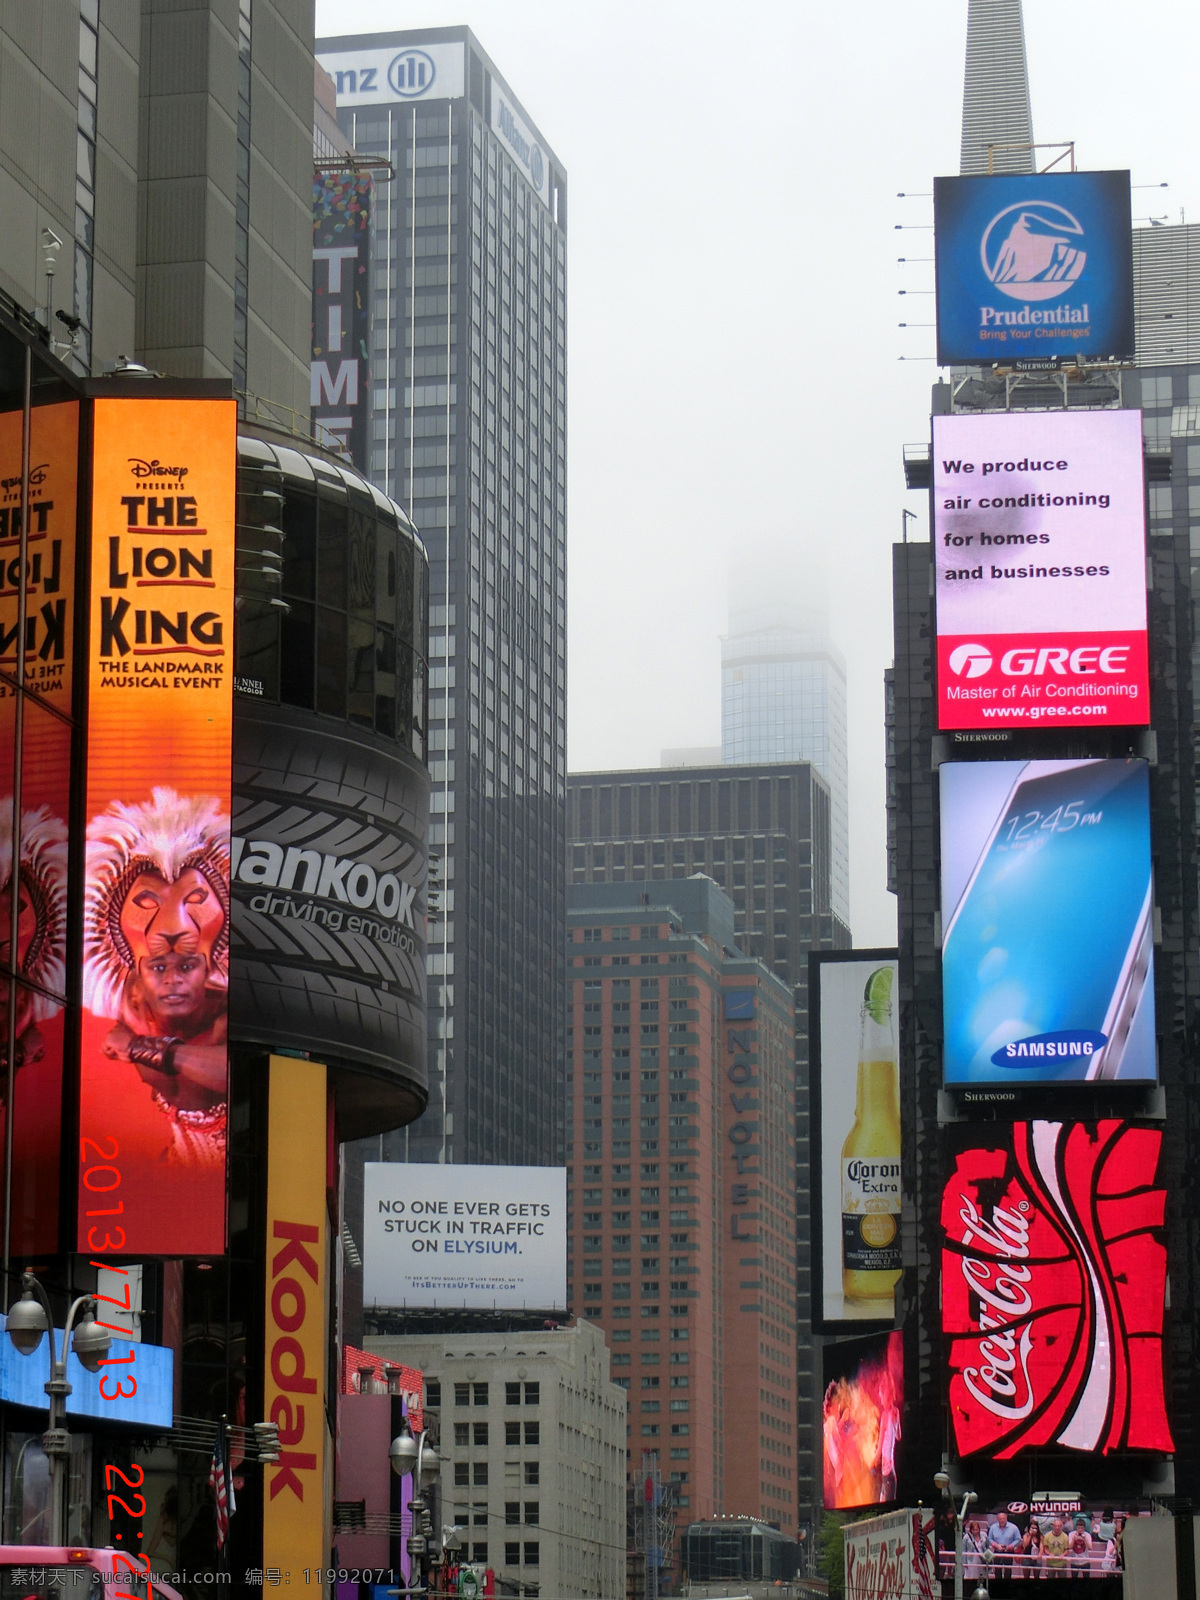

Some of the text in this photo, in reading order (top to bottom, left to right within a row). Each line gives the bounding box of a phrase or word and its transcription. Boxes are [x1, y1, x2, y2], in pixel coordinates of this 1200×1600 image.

[980, 304, 1089, 326] Prudential
[980, 327, 1089, 341] Bring Your Challenges
[943, 458, 1068, 476] We produce
[943, 492, 1110, 510] air conditioning
[121, 496, 198, 526] THE
[944, 531, 1050, 547] for homes
[108, 536, 213, 589] LION
[945, 564, 1110, 580] and businesses
[100, 596, 223, 657] KING
[99, 661, 223, 674] THE LANDMARK
[1000, 646, 1130, 676] GREE
[100, 677, 222, 688] MUSICAL EVENT
[947, 682, 1138, 700] Master of Air Conditioning
[982, 704, 1107, 719] www.gree.com
[954, 732, 1008, 742] SHERWOOD
[250, 892, 415, 954] driving emotion
[1006, 1041, 1093, 1057] SAMSUNG
[964, 1090, 1016, 1102] SHERWOOD
[728, 1029, 751, 1240] NOVOTEL
[862, 1179, 898, 1193] Extra
[378, 1200, 550, 1217] NO ONE EVER GETS
[384, 1219, 544, 1236] STUCK IN TRAFFIC
[411, 1240, 523, 1255] ON ELYSIUM.
[270, 1220, 319, 1503] Kodak
[1030, 1501, 1081, 1512] HYUNDAI
